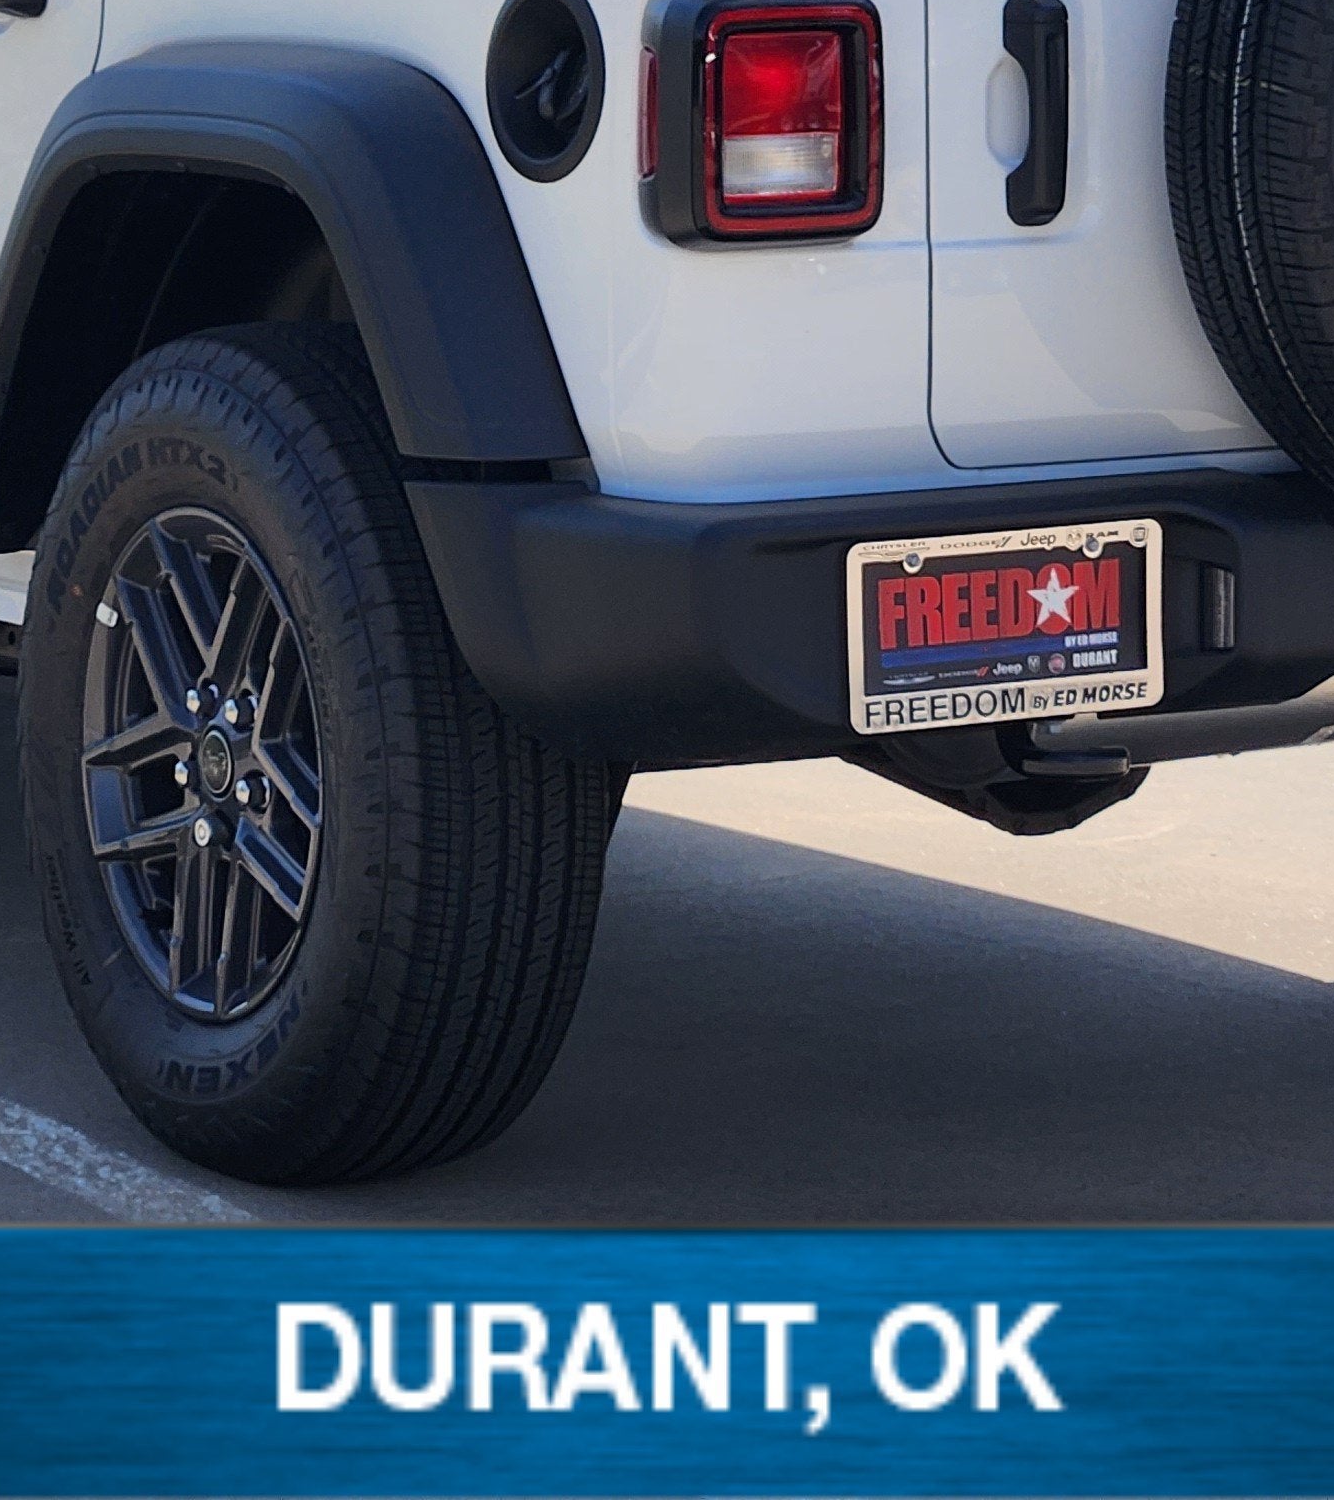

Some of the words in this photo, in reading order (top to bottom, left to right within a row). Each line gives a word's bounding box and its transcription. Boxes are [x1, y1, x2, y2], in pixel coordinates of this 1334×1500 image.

[1020, 531, 1057, 547] Jeep
[876, 558, 1121, 651] FREEDOM
[1072, 648, 1118, 668] DURANT
[865, 687, 1026, 730] FREEDOM
[1053, 688, 1078, 707] ED
[1081, 682, 1147, 704] MORSE
